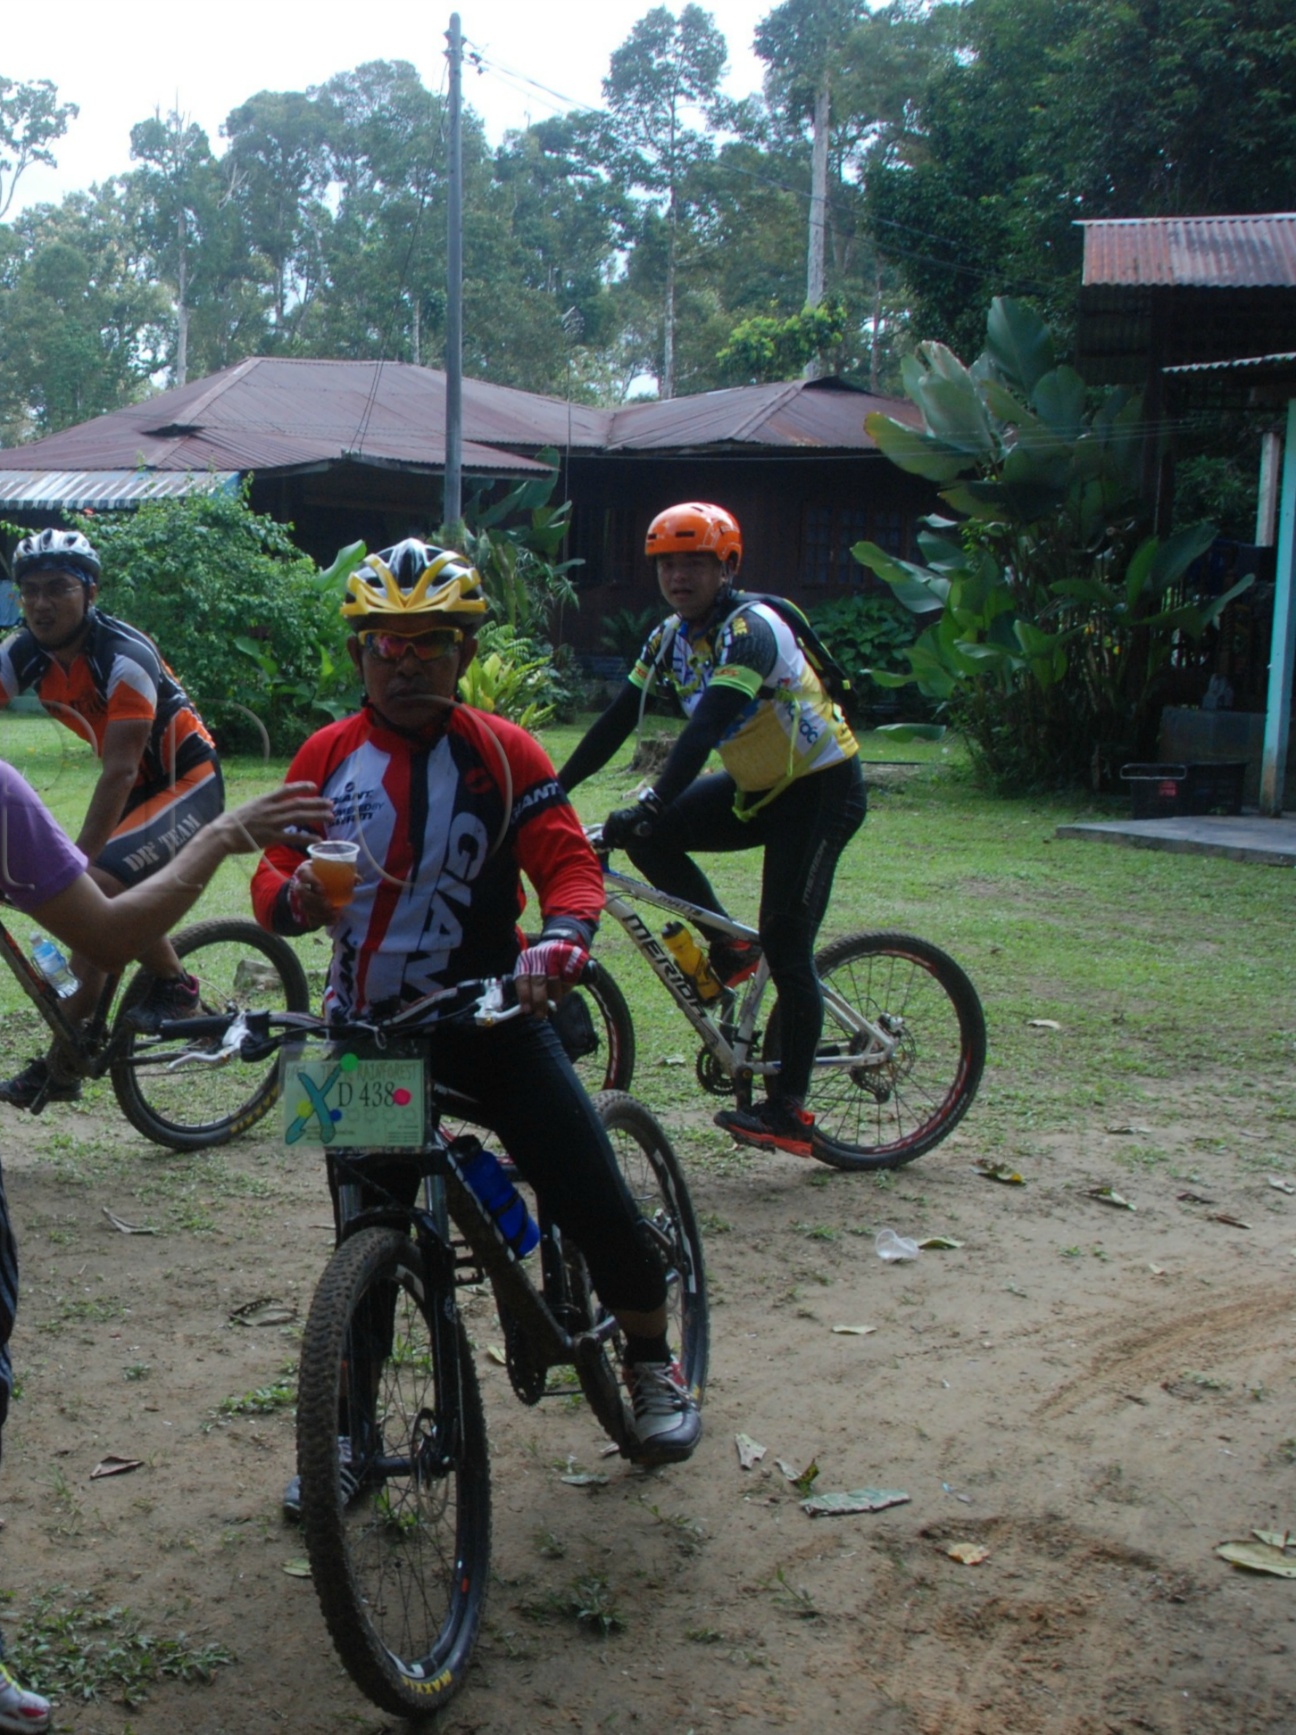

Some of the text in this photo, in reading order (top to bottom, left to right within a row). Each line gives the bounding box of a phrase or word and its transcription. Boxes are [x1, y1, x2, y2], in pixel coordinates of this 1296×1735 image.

[158, 813, 202, 849] TEAM
[399, 812, 489, 1004] GIAN
[622, 914, 708, 1019] MERIDA
[338, 1082, 396, 1107] D 438
[401, 1668, 454, 1695] MAXXIS
